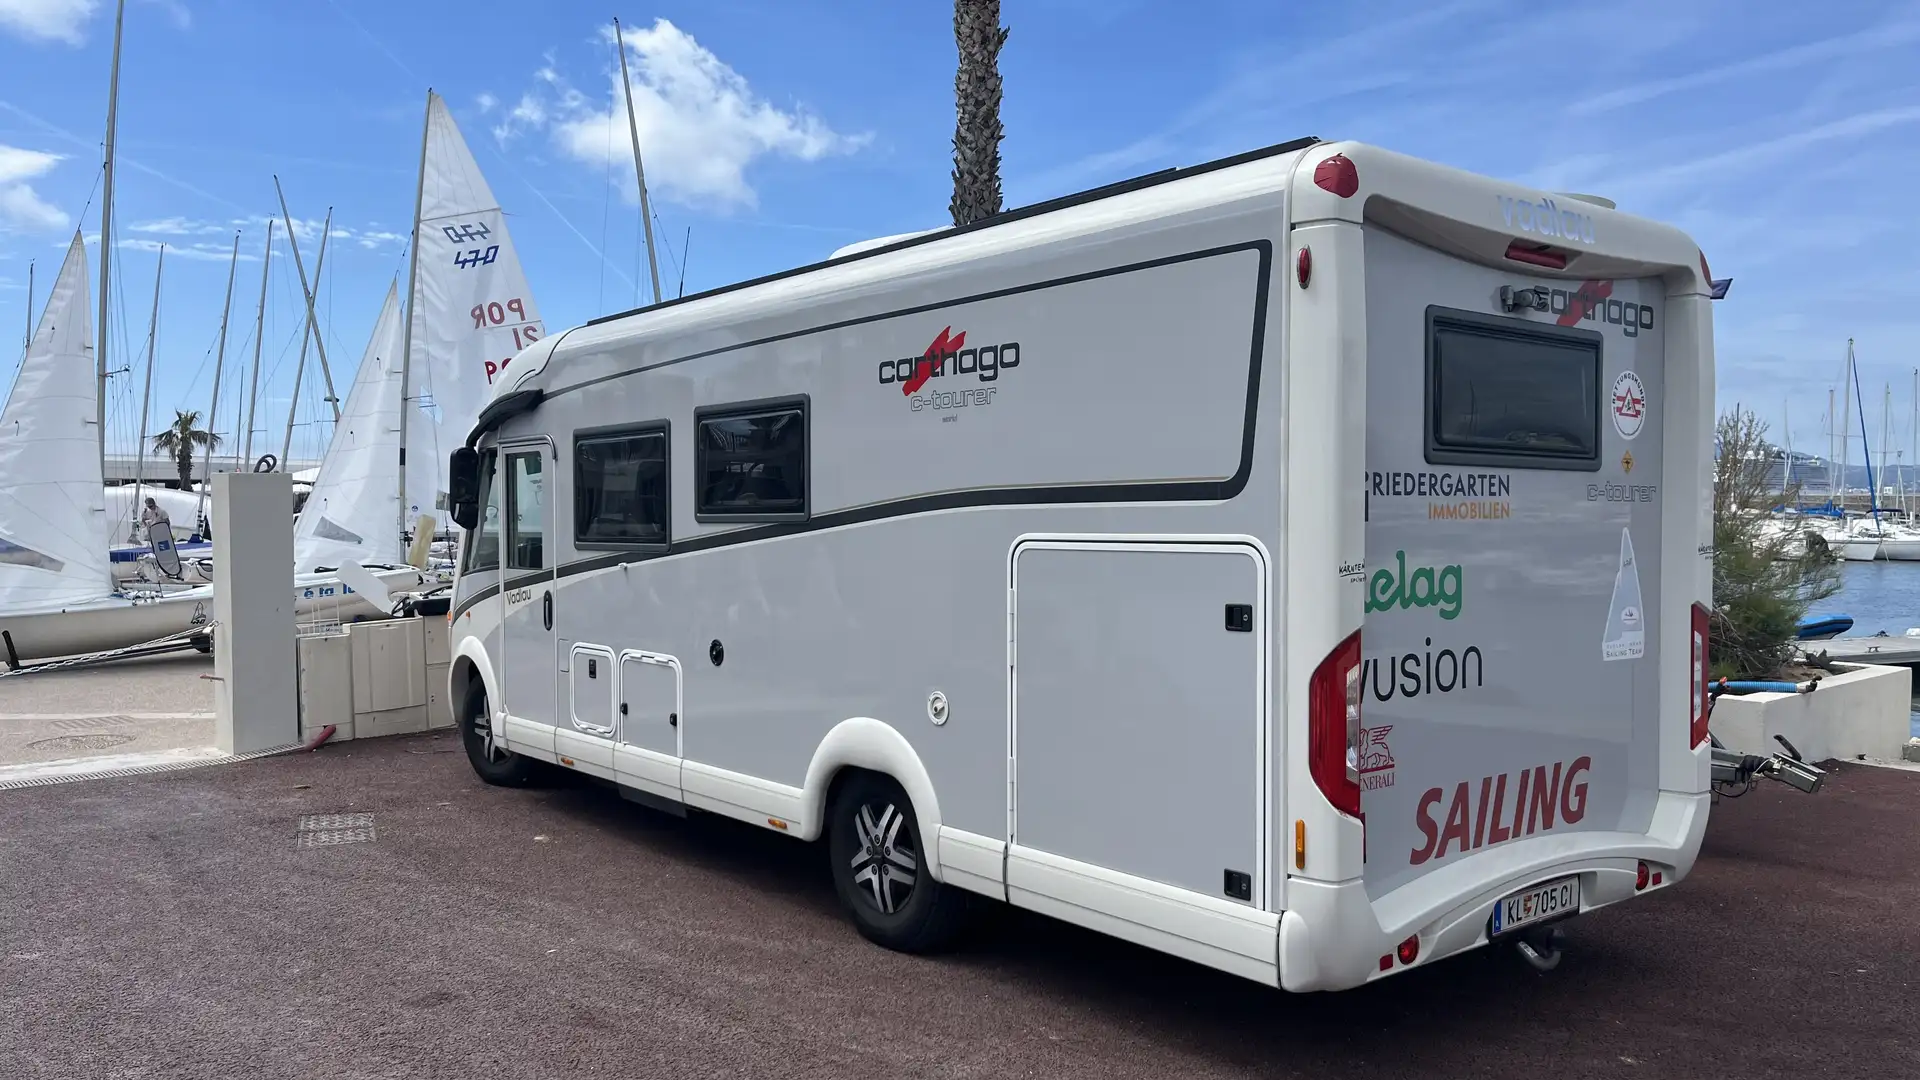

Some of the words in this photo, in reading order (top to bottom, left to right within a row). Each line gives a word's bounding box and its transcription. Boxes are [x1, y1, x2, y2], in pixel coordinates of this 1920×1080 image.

[454, 245, 499, 269] 470
[879, 342, 1020, 384] carthago
[911, 387, 996, 412] c-tourer
[1587, 481, 1656, 503] c-tourer
[1428, 502, 1510, 520] IMMOBILIEN
[506, 588, 531, 605] Vadlau
[1365, 550, 1462, 620] elag
[1360, 772, 1395, 792] NERALI
[1409, 756, 1592, 865] SAILING
[1508, 899, 1522, 925] KL
[1533, 888, 1558, 916] 705
